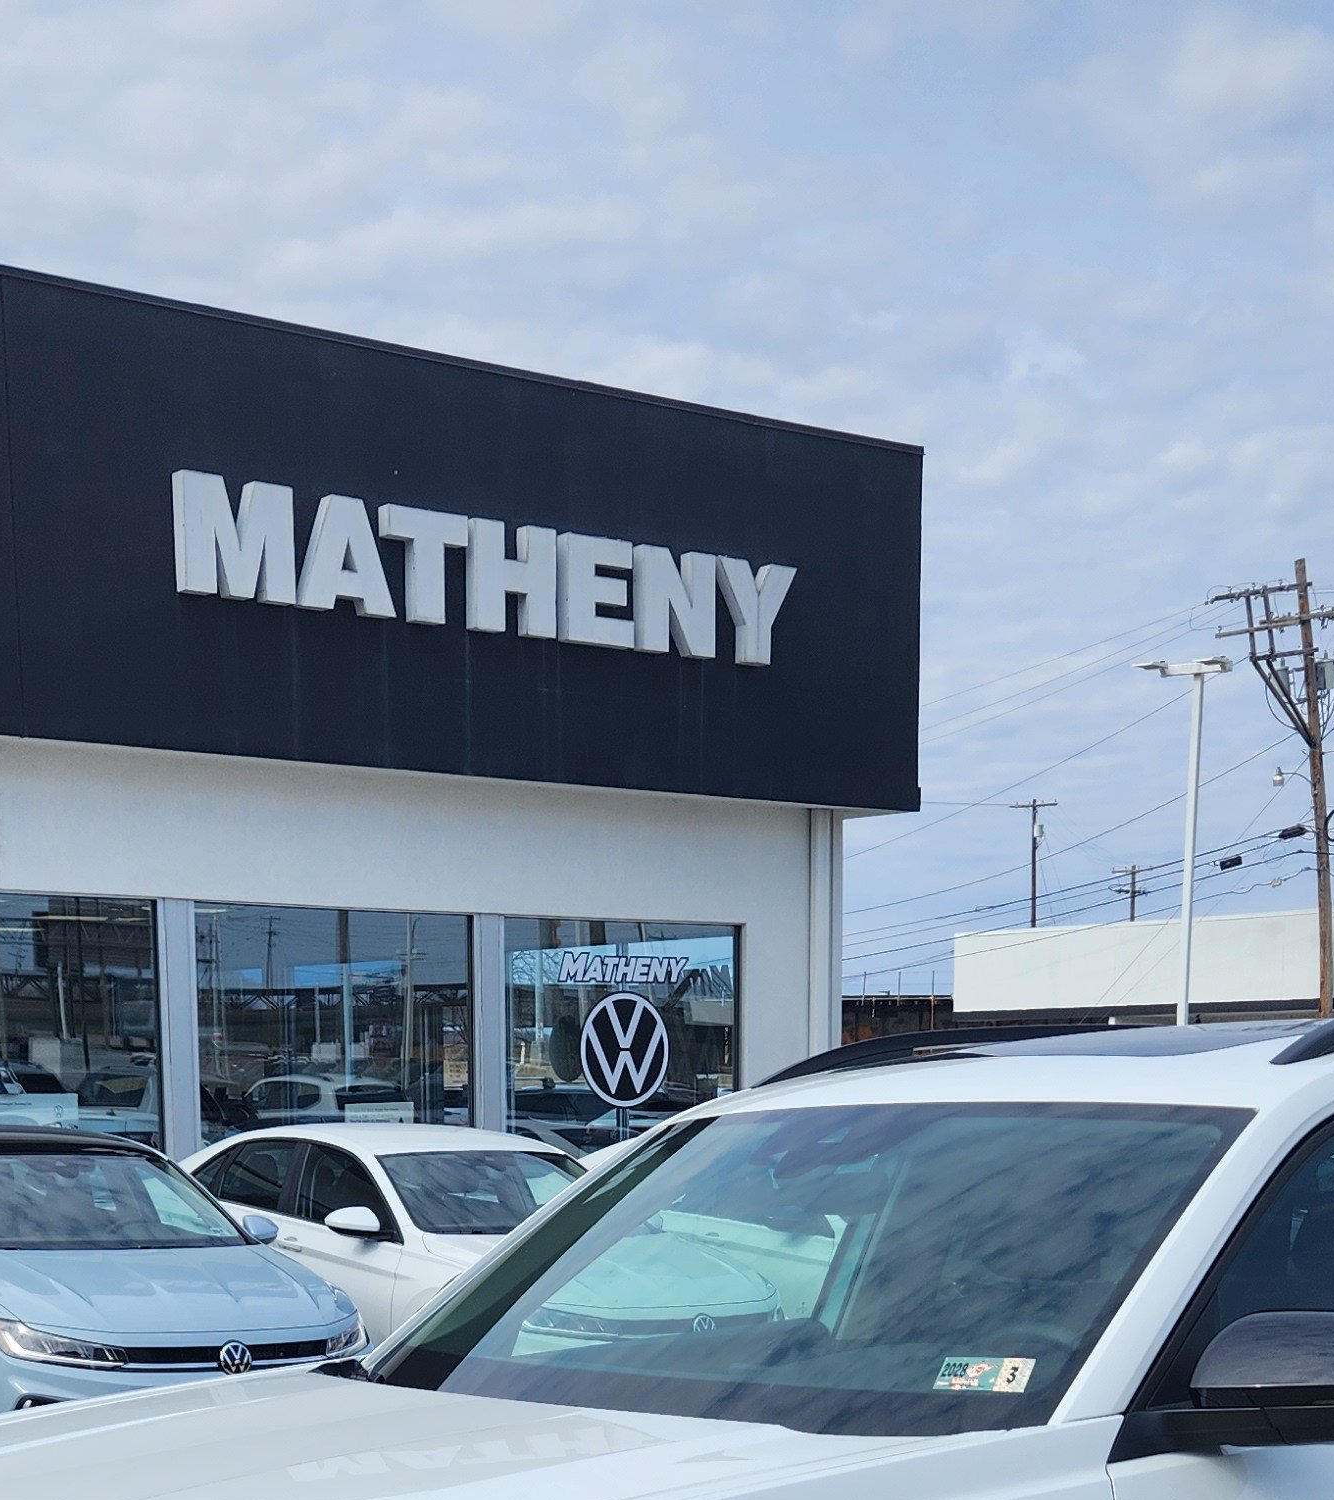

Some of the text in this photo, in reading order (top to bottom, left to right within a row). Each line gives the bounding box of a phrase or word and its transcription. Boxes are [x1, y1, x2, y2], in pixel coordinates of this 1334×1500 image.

[172, 468, 797, 667] MATHENY
[559, 951, 688, 983] MATHENY
[584, 997, 666, 1099] VW
[940, 1362, 1020, 1384] 2028 3
